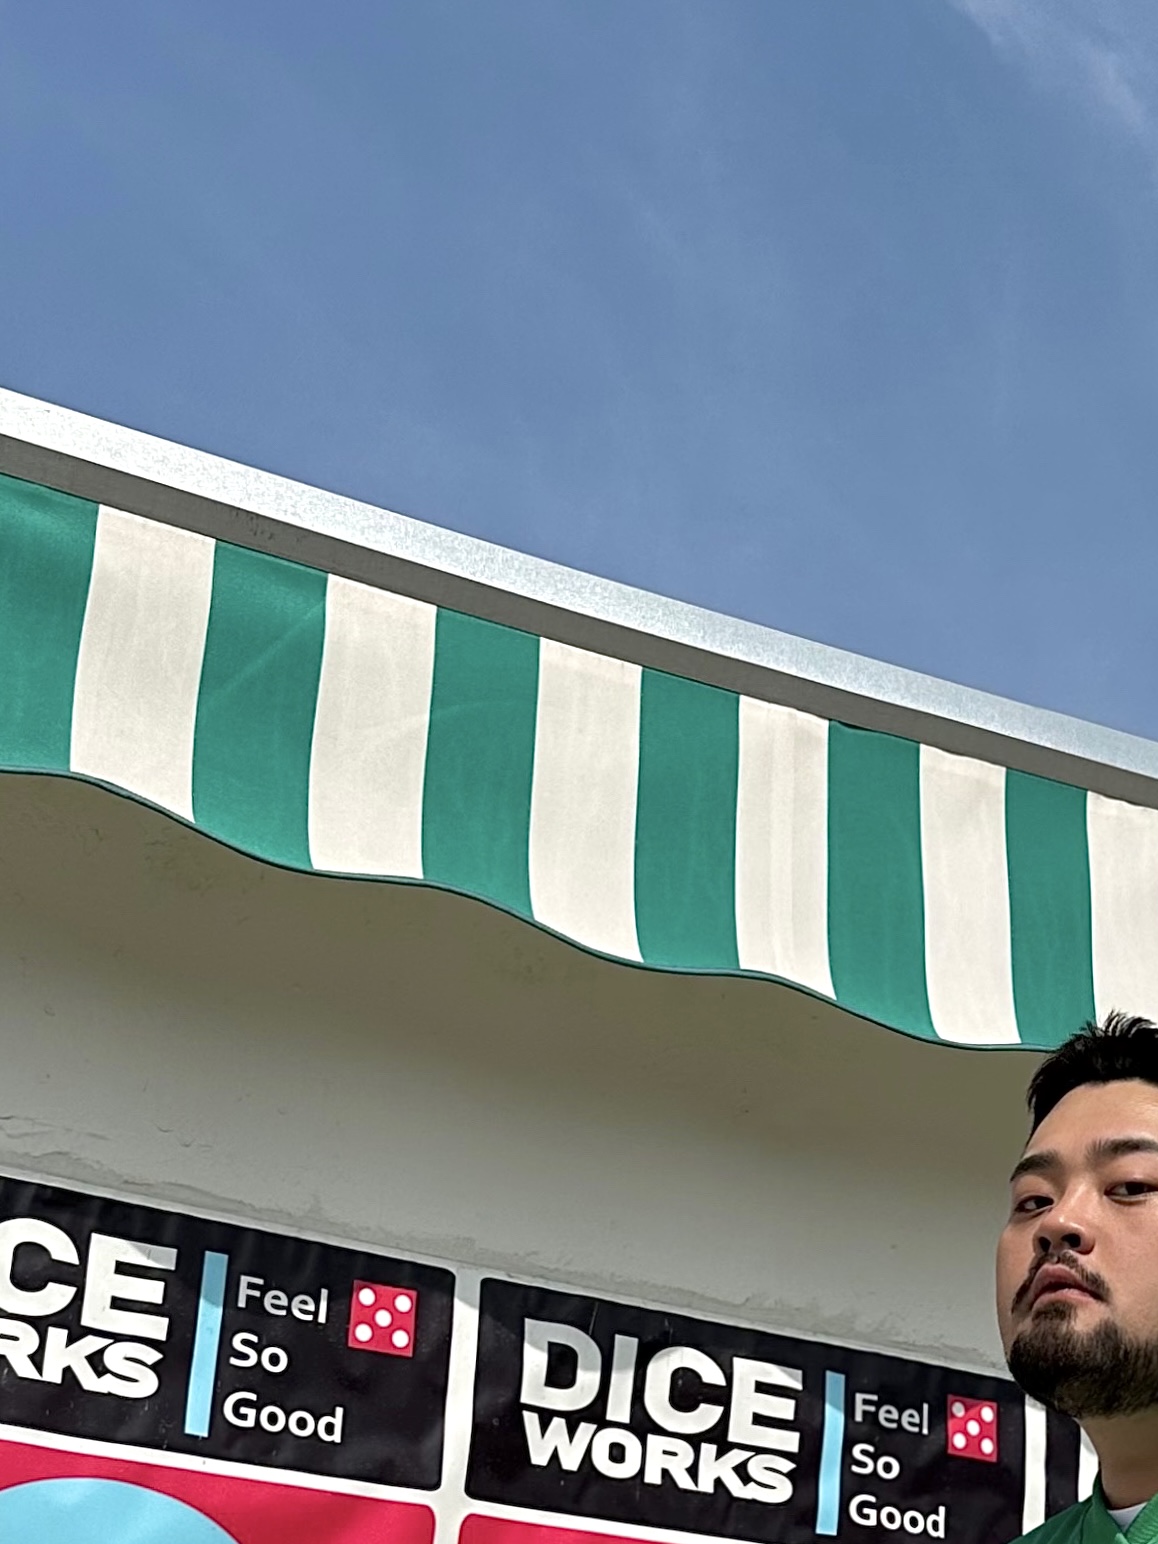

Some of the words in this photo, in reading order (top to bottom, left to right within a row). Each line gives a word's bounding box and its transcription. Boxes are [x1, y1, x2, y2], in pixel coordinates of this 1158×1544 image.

[237, 1275, 328, 1324] Feel
[229, 1332, 289, 1374] So
[520, 1318, 803, 1453] DICE
[223, 1391, 345, 1443] Good
[854, 1392, 929, 1435] Feel
[522, 1410, 797, 1504] WORKS
[850, 1443, 900, 1480] So
[849, 1493, 946, 1539] Good
